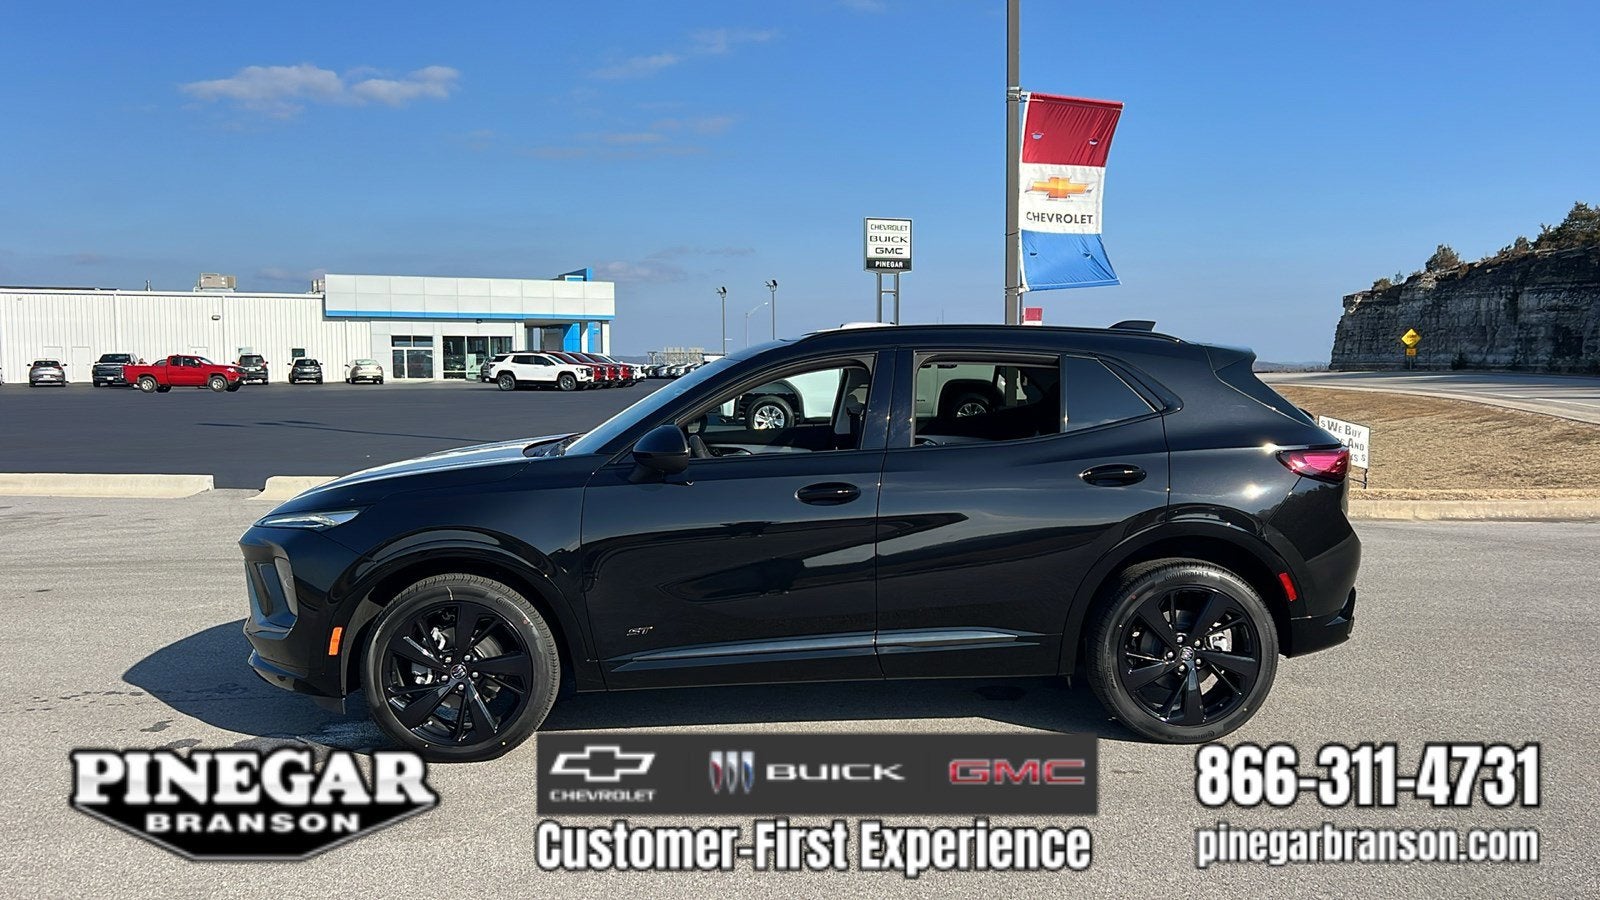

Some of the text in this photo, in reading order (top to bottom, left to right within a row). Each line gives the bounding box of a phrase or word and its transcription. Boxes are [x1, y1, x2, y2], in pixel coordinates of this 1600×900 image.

[1026, 211, 1093, 224] CHEVROLET
[870, 223, 908, 232] CHEVROLET
[869, 235, 908, 243] BUICK
[875, 247, 904, 255] GMC
[875, 260, 904, 268] PINEGAR
[1345, 425, 1361, 438] BUY
[1348, 438, 1364, 451] AND
